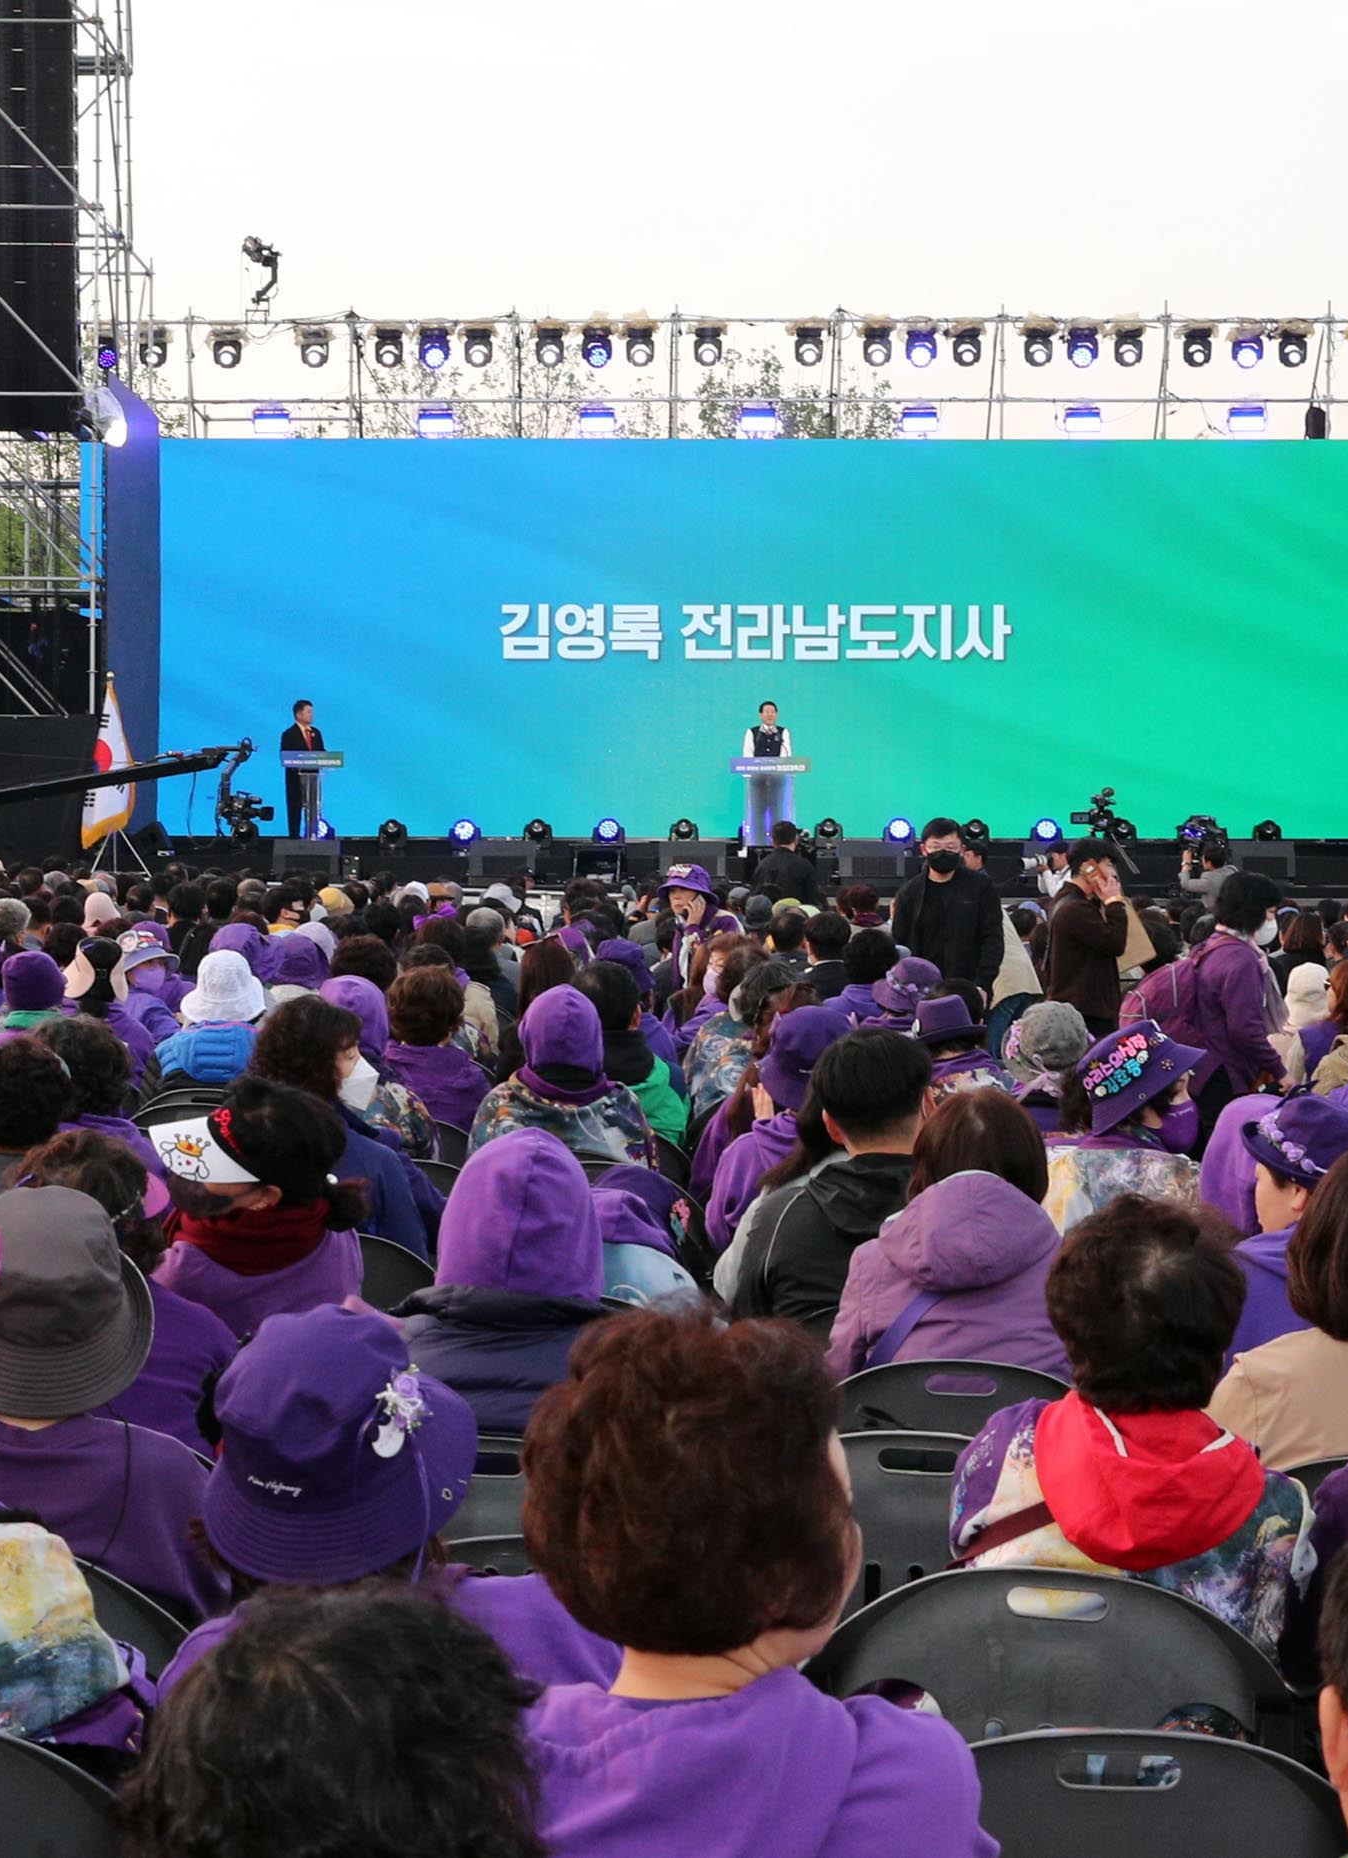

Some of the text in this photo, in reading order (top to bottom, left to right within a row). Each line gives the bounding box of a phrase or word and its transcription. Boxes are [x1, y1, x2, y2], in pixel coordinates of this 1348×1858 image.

[501, 604, 1011, 660] 김영록 전라남도지사
[1100, 1058, 1142, 1094] 김호중
